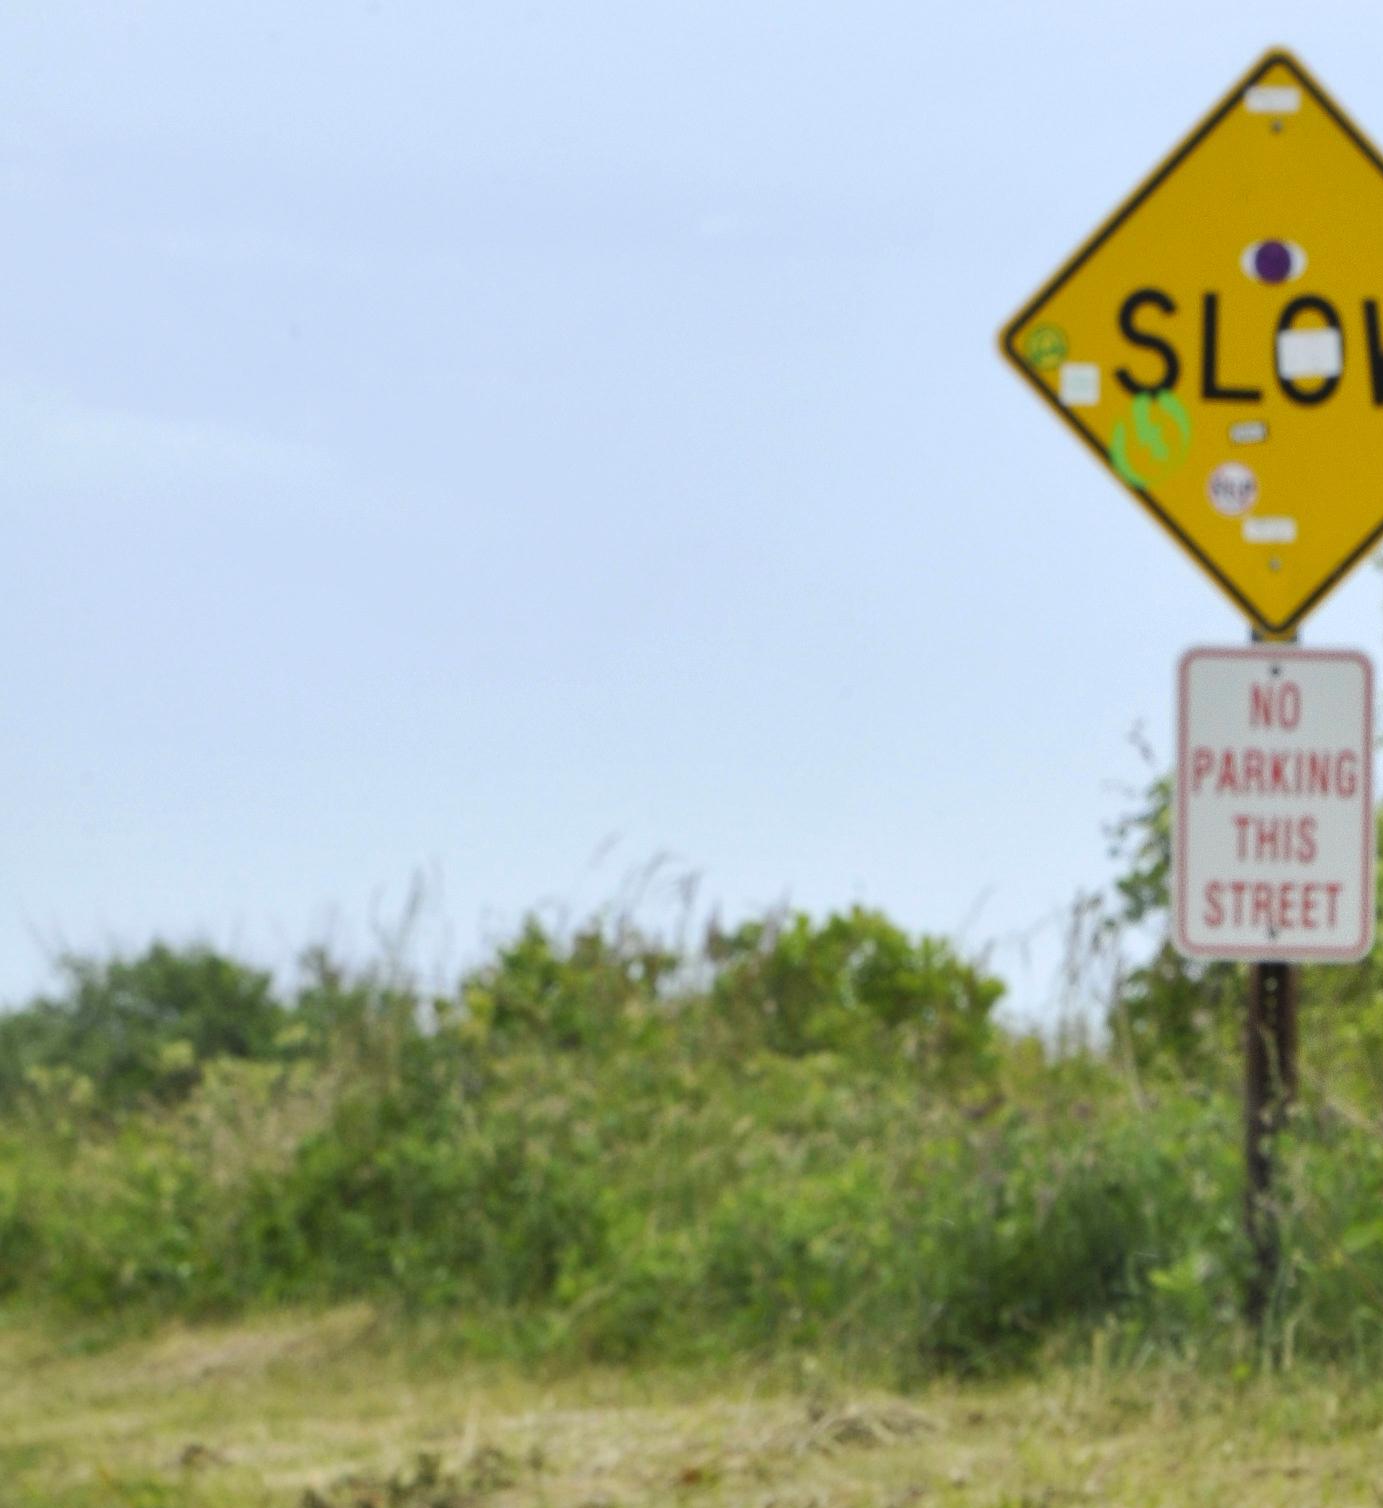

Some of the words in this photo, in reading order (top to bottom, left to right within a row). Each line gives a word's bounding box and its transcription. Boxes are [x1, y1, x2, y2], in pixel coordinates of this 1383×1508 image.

[1249, 681, 1301, 730] NO
[1192, 747, 1358, 798] PARKING
[1232, 814, 1318, 862] THIS
[1204, 879, 1342, 928] STREET
